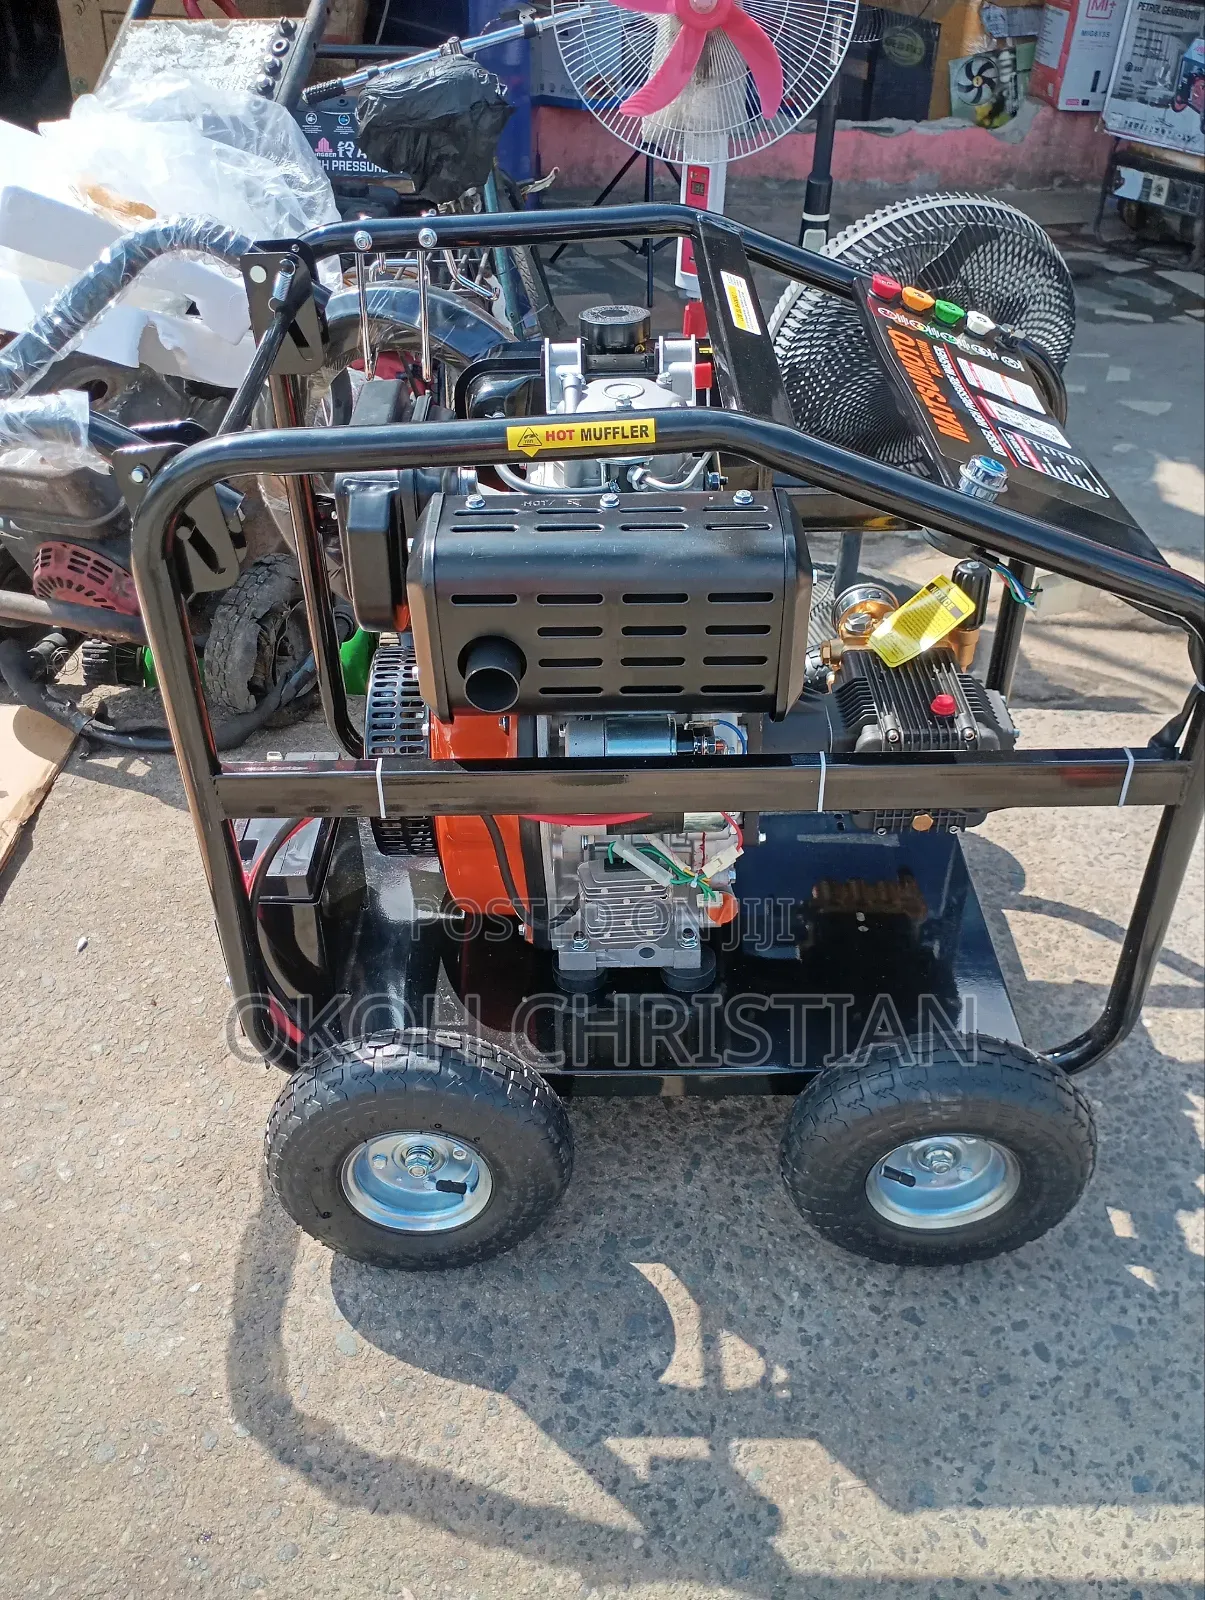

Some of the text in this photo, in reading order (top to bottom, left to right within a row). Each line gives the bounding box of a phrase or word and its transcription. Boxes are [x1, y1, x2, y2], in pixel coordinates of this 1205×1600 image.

[888, 329, 970, 442] MATSUMOTO
[545, 424, 650, 442] HOT MUFFLER
[930, 586, 955, 611] NOTICE
